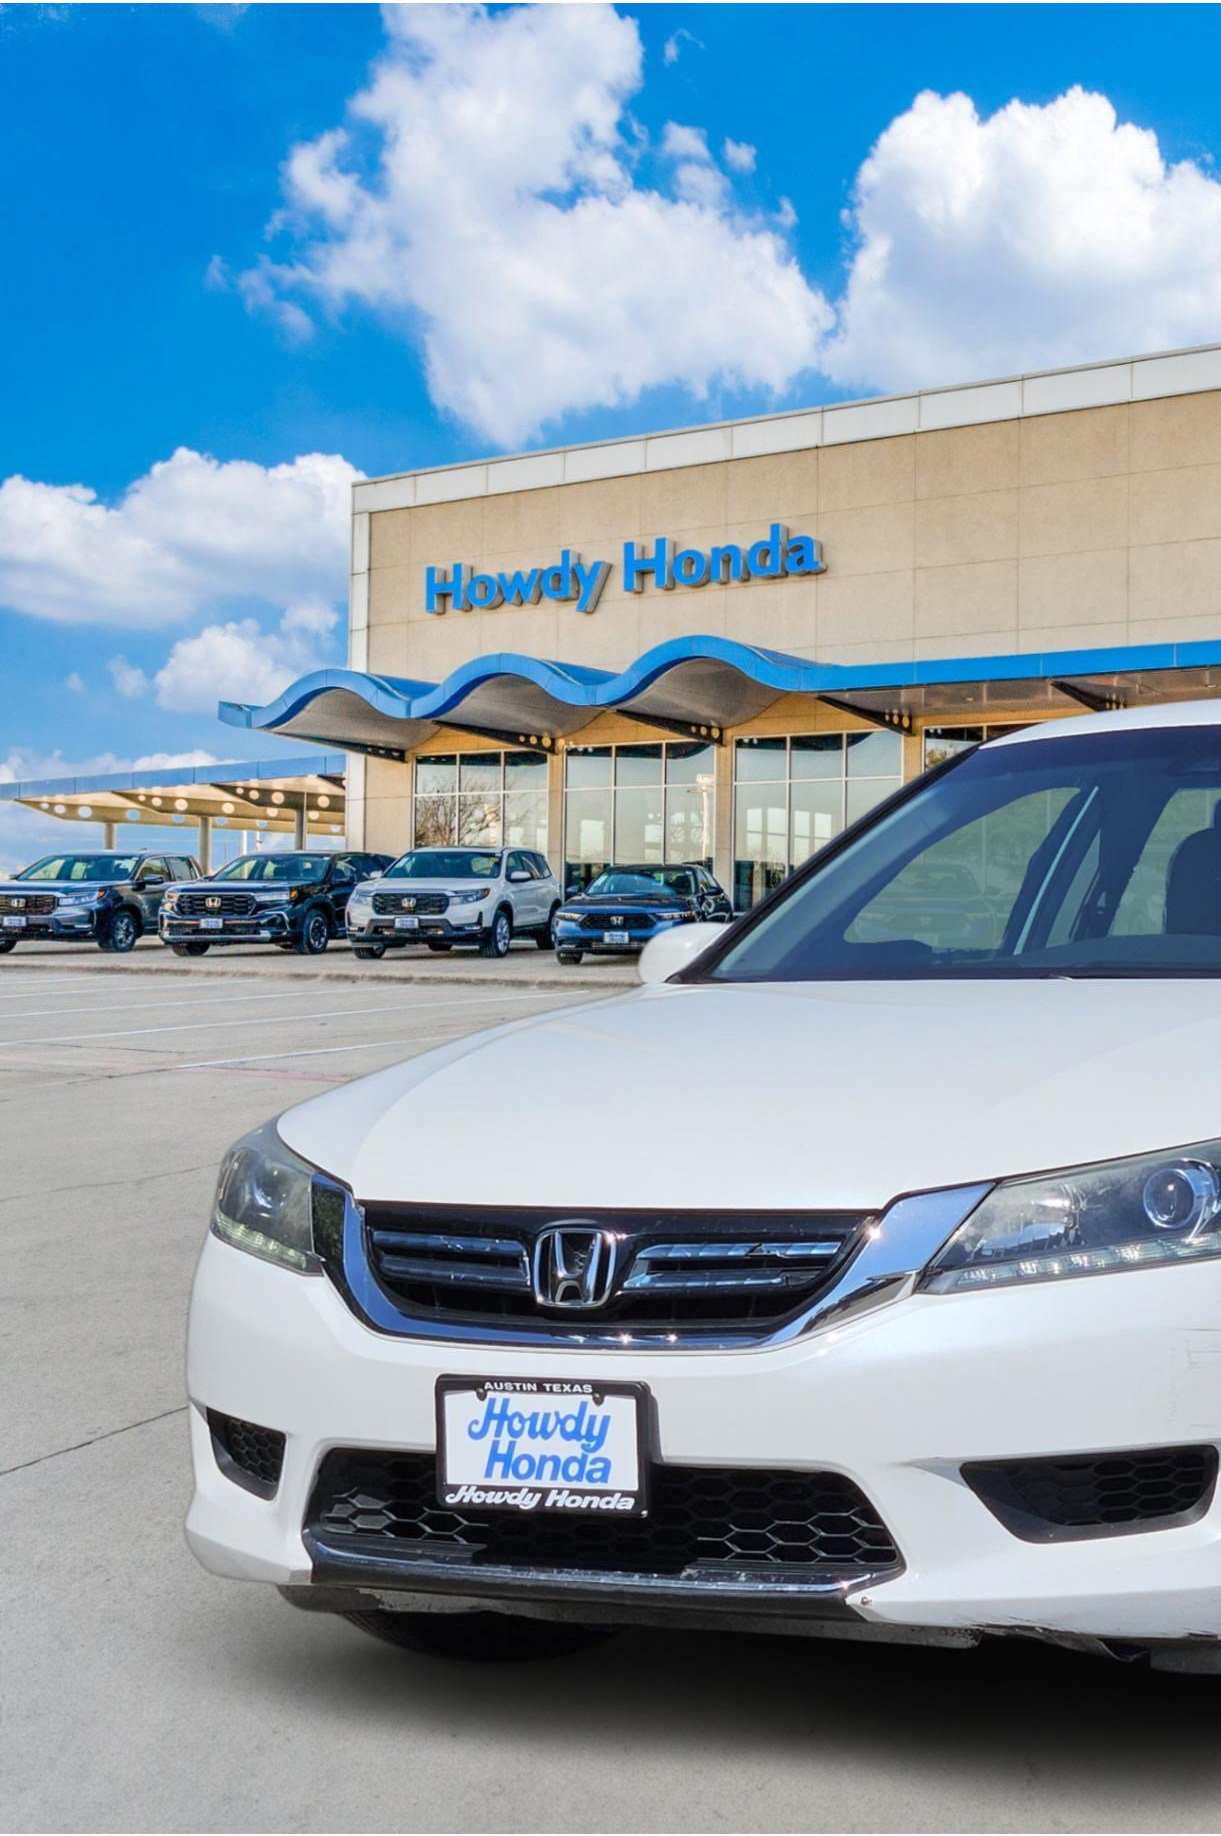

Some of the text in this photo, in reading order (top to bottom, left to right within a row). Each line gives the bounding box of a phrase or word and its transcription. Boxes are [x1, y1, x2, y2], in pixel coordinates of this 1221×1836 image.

[425, 523, 827, 614] Howdy Honda
[484, 1381, 593, 1393] AUSTIN TEXAS
[468, 1398, 611, 1453] Howdy
[484, 1440, 612, 1484] Honda
[445, 1486, 636, 1511] Howdy Honda
